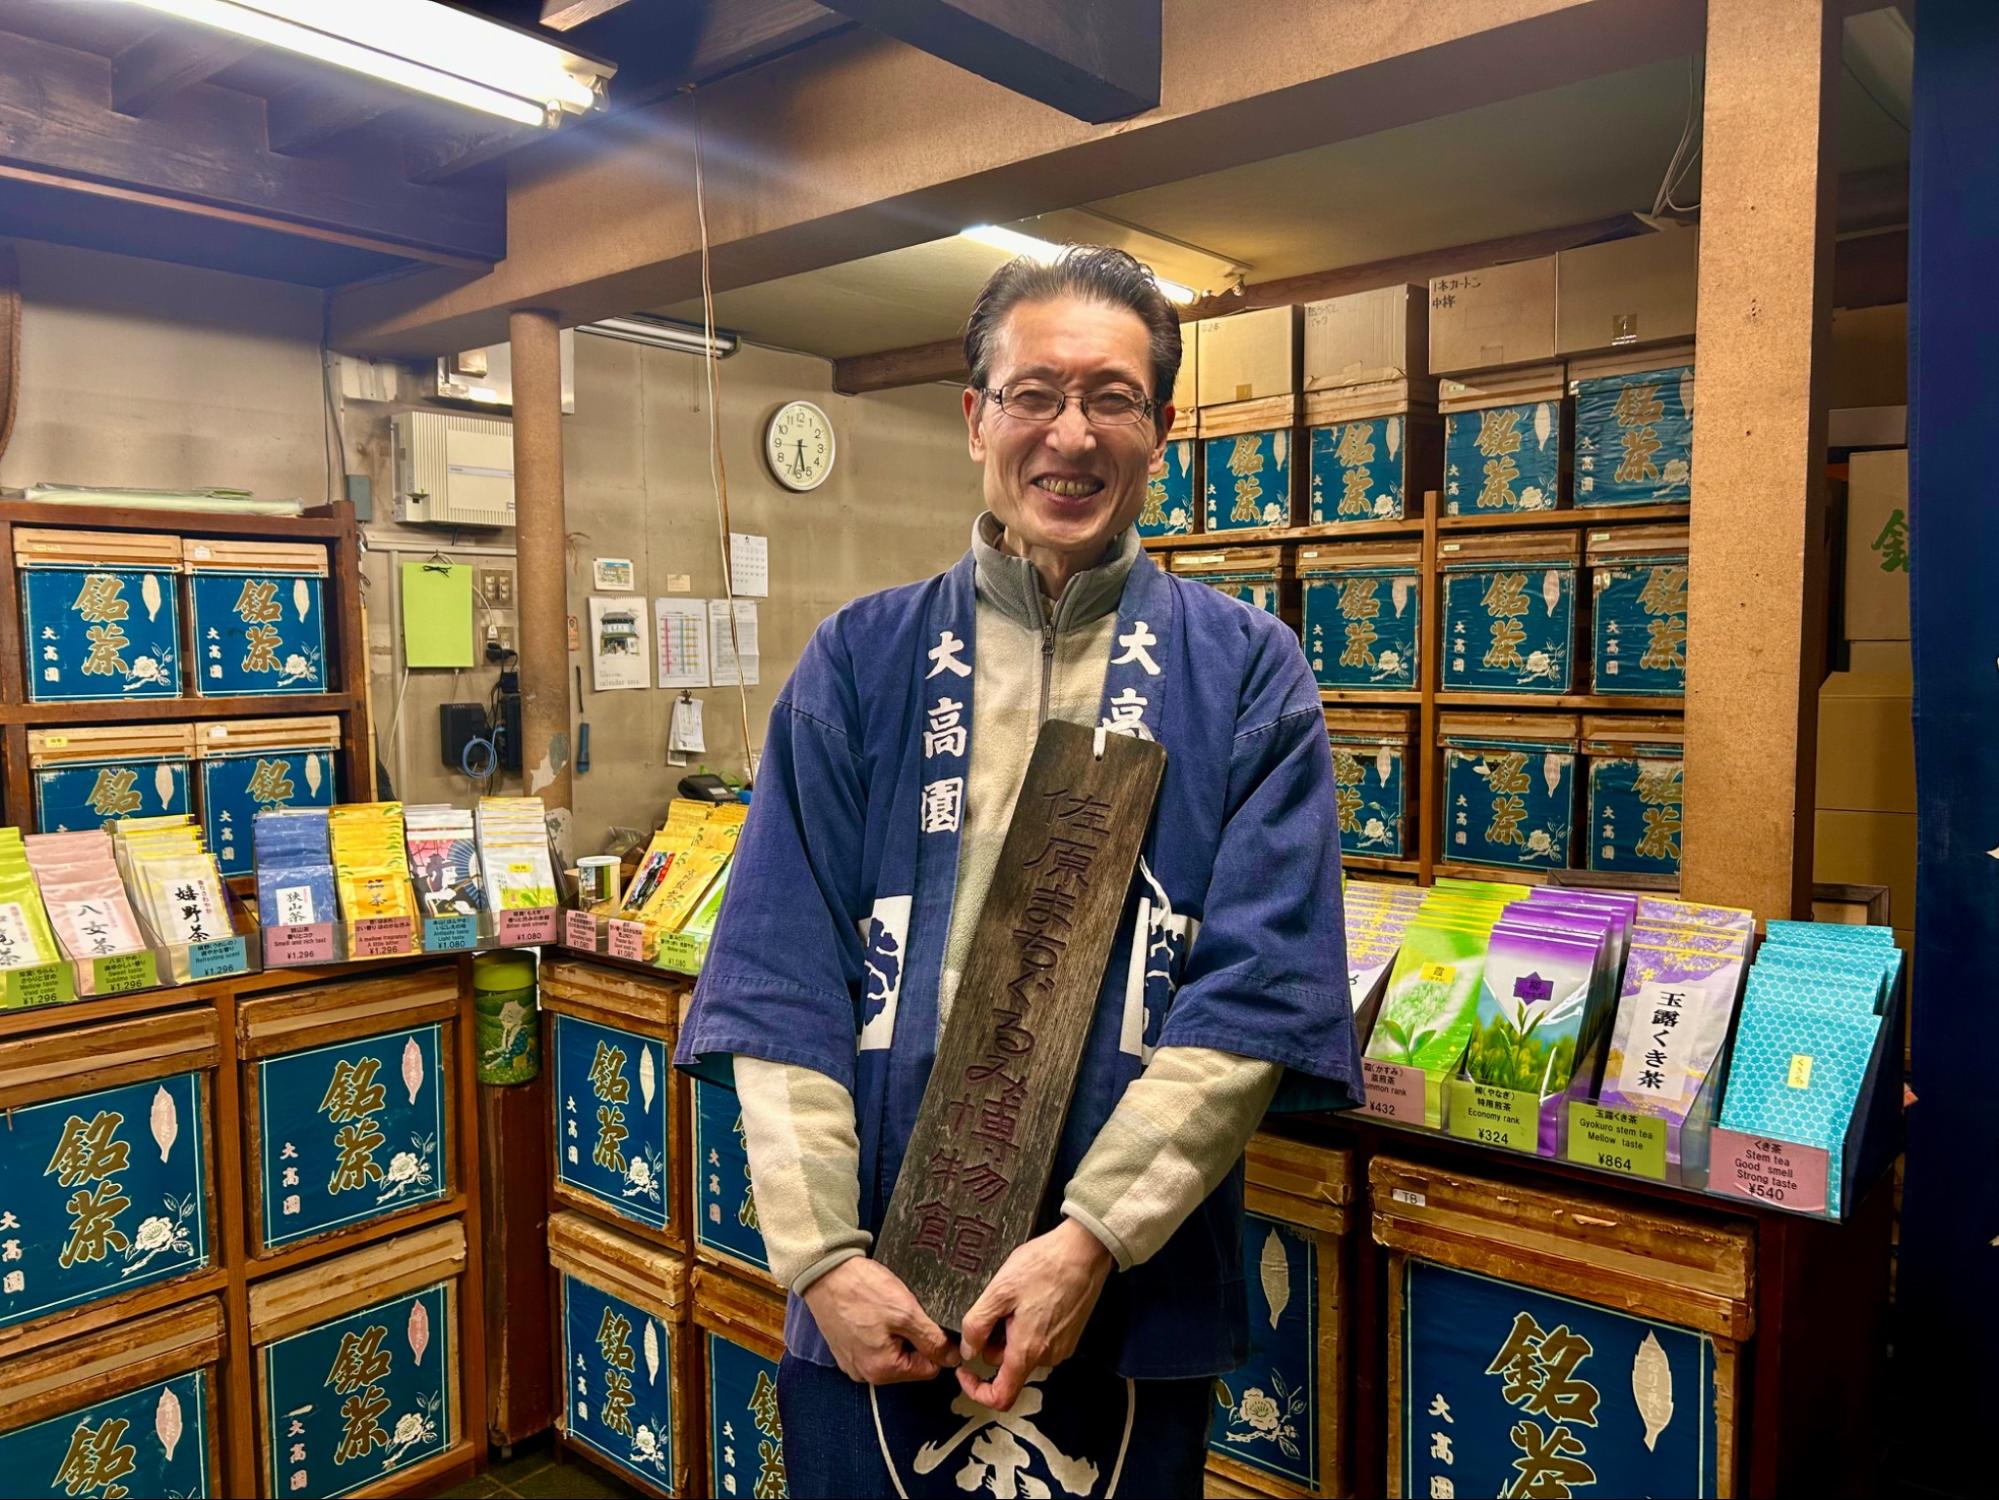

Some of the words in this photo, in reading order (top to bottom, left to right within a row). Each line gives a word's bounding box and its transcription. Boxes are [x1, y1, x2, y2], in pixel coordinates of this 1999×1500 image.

[1474, 409, 1521, 508] 銘茶
[1611, 383, 1664, 482] 銘茶
[1227, 435, 1263, 522] 銘茶
[1335, 424, 1375, 515] 銘茶
[1447, 464, 1459, 514] 大高園
[1581, 437, 1594, 491] 大高園
[72, 574, 129, 676] 銘茶
[233, 578, 282, 673] 銘茶
[1337, 578, 1379, 667] 銘茶
[1453, 622, 1465, 671] 大高園
[1481, 573, 1530, 669] 銘茶
[1637, 568, 1687, 669] 銘茶
[41, 627, 60, 682] 大高園
[207, 627, 222, 678] 大高園
[1606, 621, 1618, 675] 大高園
[924, 630, 974, 834] 大高園
[1456, 794, 1467, 845] 大高園
[1485, 752, 1532, 845] 銘茶
[219, 810, 234, 861] 大高園
[1602, 806, 1615, 860] 大高園
[78, 905, 115, 955] 八女茶
[174, 884, 210, 942] 嬉野茶
[910, 788, 1112, 1277] 佐原まちぐるみ博物館
[1638, 991, 1686, 1089] 玉露くき茶
[587, 1040, 630, 1172] 銘茶
[1370, 1101, 1396, 1116] ¥432
[1391, 1087, 1407, 1097] rank
[1468, 1108, 1501, 1122] Economy
[1503, 1115, 1521, 1125] rank
[1595, 1109, 1638, 1125] 玉露くき茶
[318, 1057, 385, 1194] 銘茶
[566, 1096, 578, 1165] 大高園
[1478, 1128, 1509, 1145] ¥324
[1579, 1118, 1613, 1132] Gyokuro
[1616, 1126, 1637, 1136] stem
[1639, 1129, 1653, 1140] tea
[1588, 1131, 1616, 1144] Mellow
[1622, 1138, 1644, 1150] taste
[1754, 1140, 1782, 1155] くき茶
[280, 1142, 300, 1215] 大高園
[1598, 1153, 1631, 1171] ¥864
[1735, 1158, 1760, 1171] Good
[1768, 1165, 1793, 1178] smell
[1737, 1169, 1769, 1185] Strong
[1772, 1177, 1798, 1190] taste
[1746, 1149, 1770, 1163] Stem
[1774, 1156, 1790, 1167] tea
[44, 1110, 131, 1268] 銘茶
[1749, 1182, 1784, 1201] ¥540
[0, 1211, 25, 1294] 大高園
[324, 1326, 391, 1465] 銘茶
[596, 1306, 635, 1438] 銘茶
[1483, 1310, 1601, 1499] 銘茶
[288, 1419, 308, 1491] 大高園
